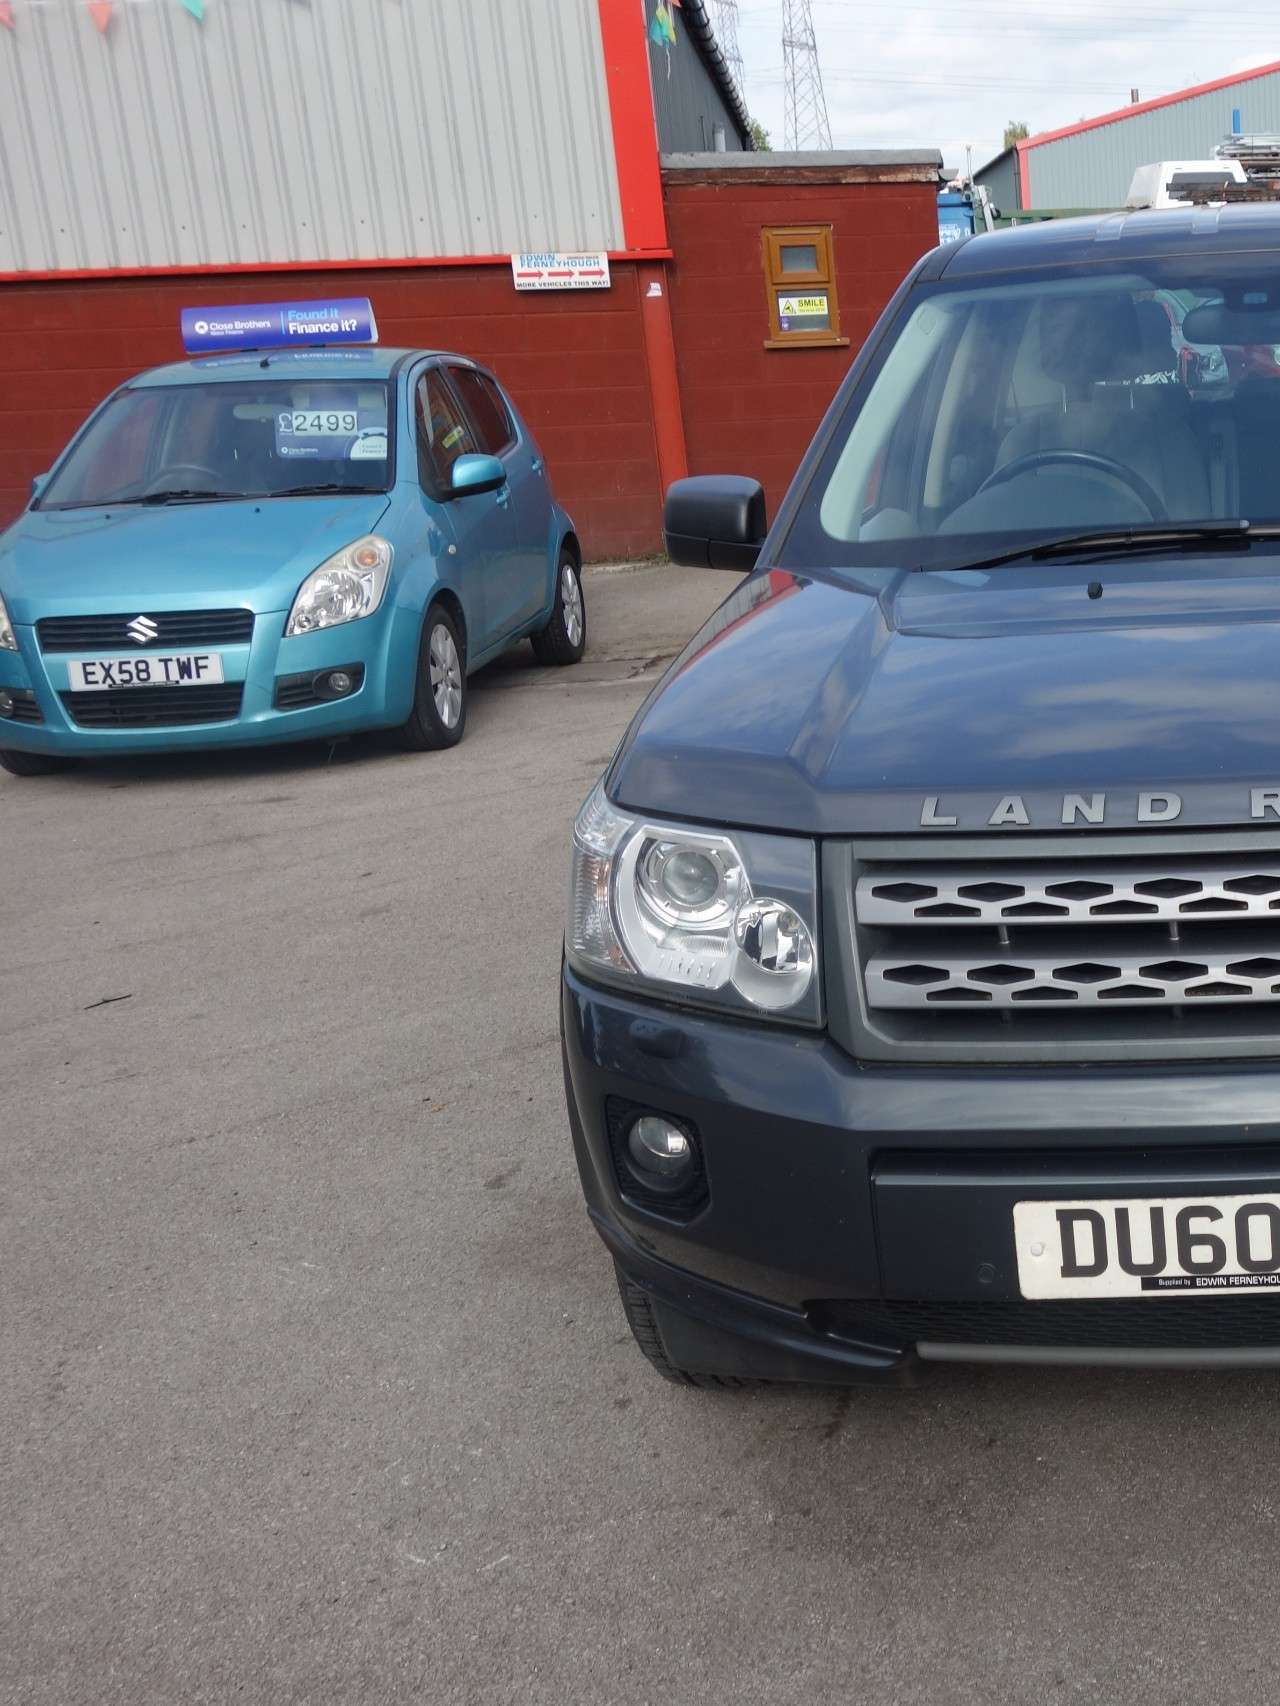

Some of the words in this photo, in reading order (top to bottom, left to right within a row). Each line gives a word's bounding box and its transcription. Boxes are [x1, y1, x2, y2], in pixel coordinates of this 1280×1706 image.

[521, 258, 600, 269] FERNEYHOUGH
[798, 299, 825, 307] SMILE
[288, 308, 328, 320] Found
[330, 307, 339, 319] it
[210, 322, 233, 330] Close
[289, 321, 339, 334] Finance
[341, 319, 357, 332] it?
[82, 659, 151, 685] EX58
[158, 656, 209, 682] TWF
[920, 791, 1182, 826] LAND
[1196, 1276, 1227, 1287] EDWIN
